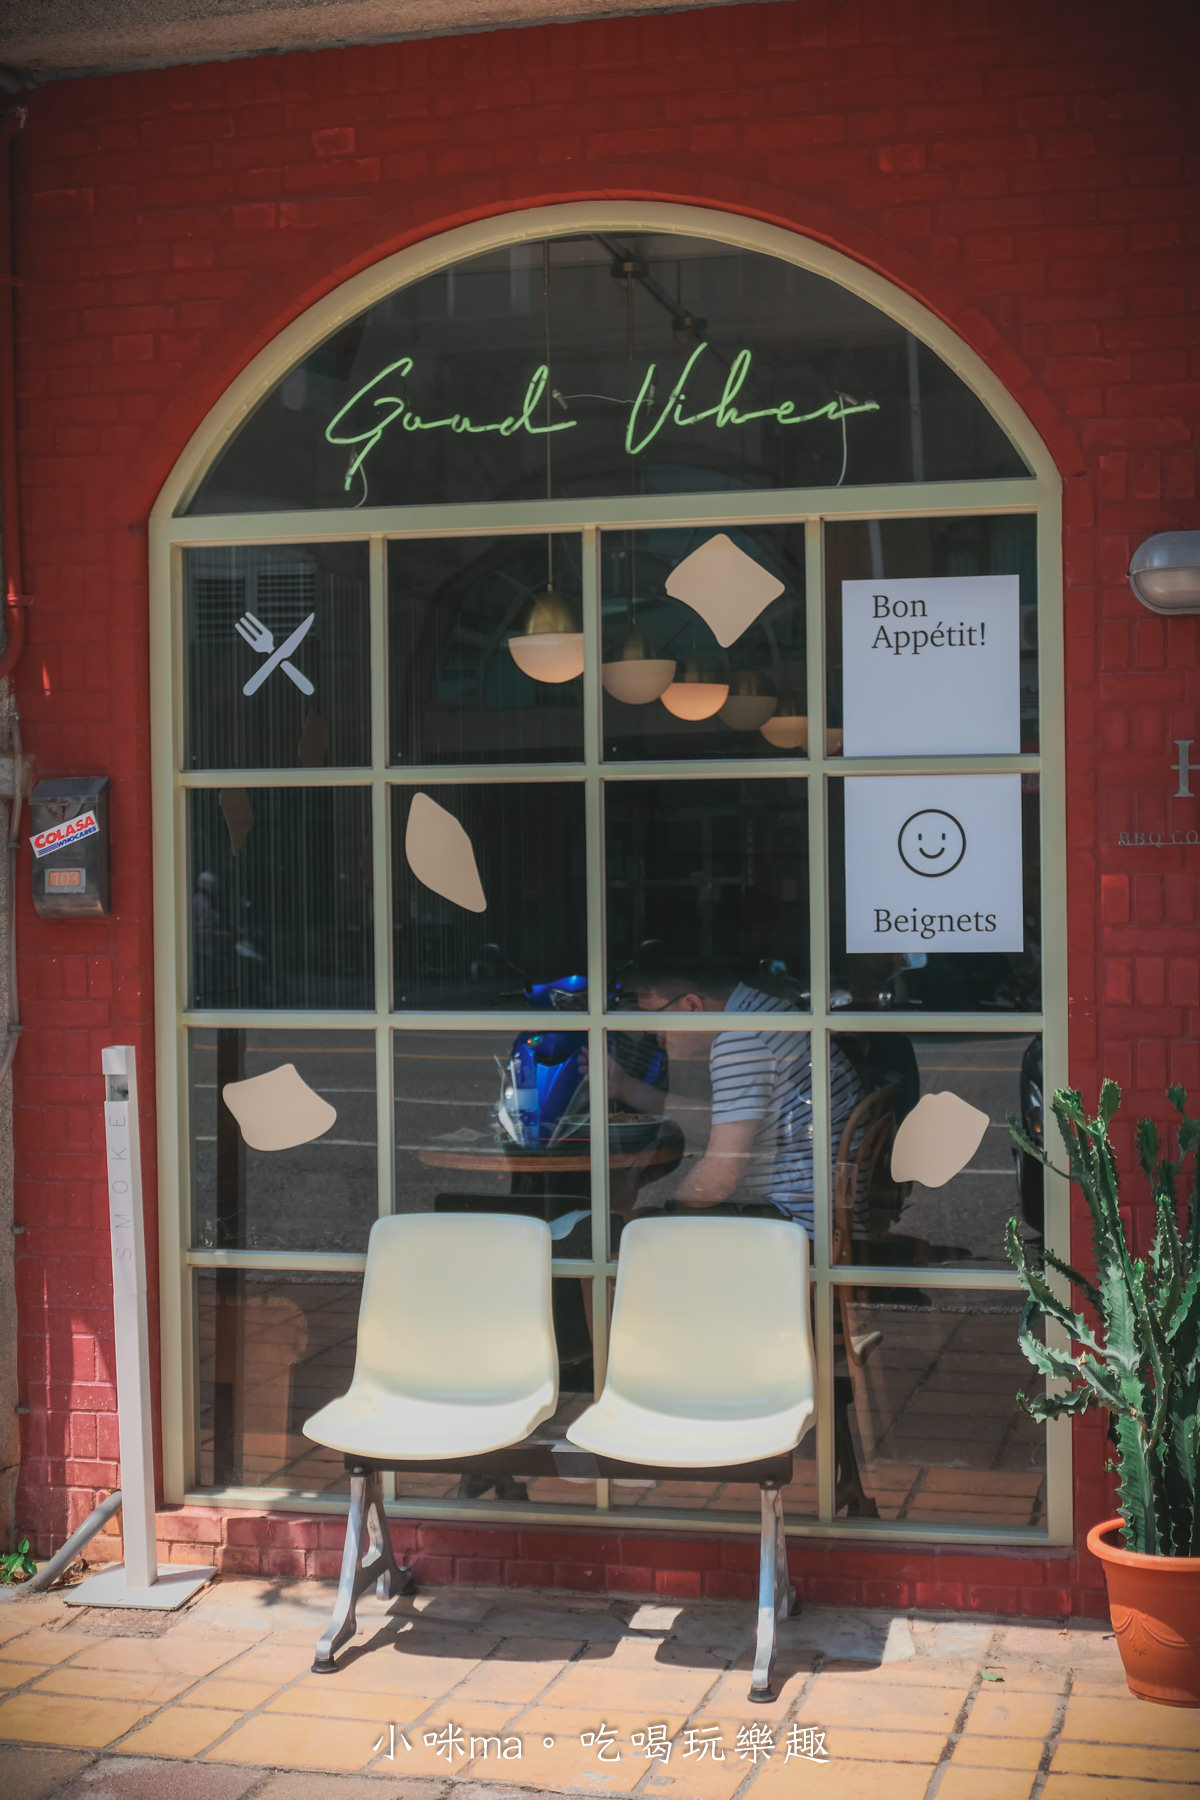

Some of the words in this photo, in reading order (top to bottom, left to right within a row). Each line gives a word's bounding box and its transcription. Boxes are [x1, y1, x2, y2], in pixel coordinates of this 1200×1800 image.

[325, 357, 577, 491] Good
[625, 341, 880, 454] Vibes
[872, 594, 928, 618] Bon
[871, 621, 986, 655] Appétit!
[34, 815, 96, 849] COLASA
[57, 825, 97, 848] WHOCARES
[873, 907, 997, 939] Beignets
[109, 1115, 132, 1260] SMOKE
